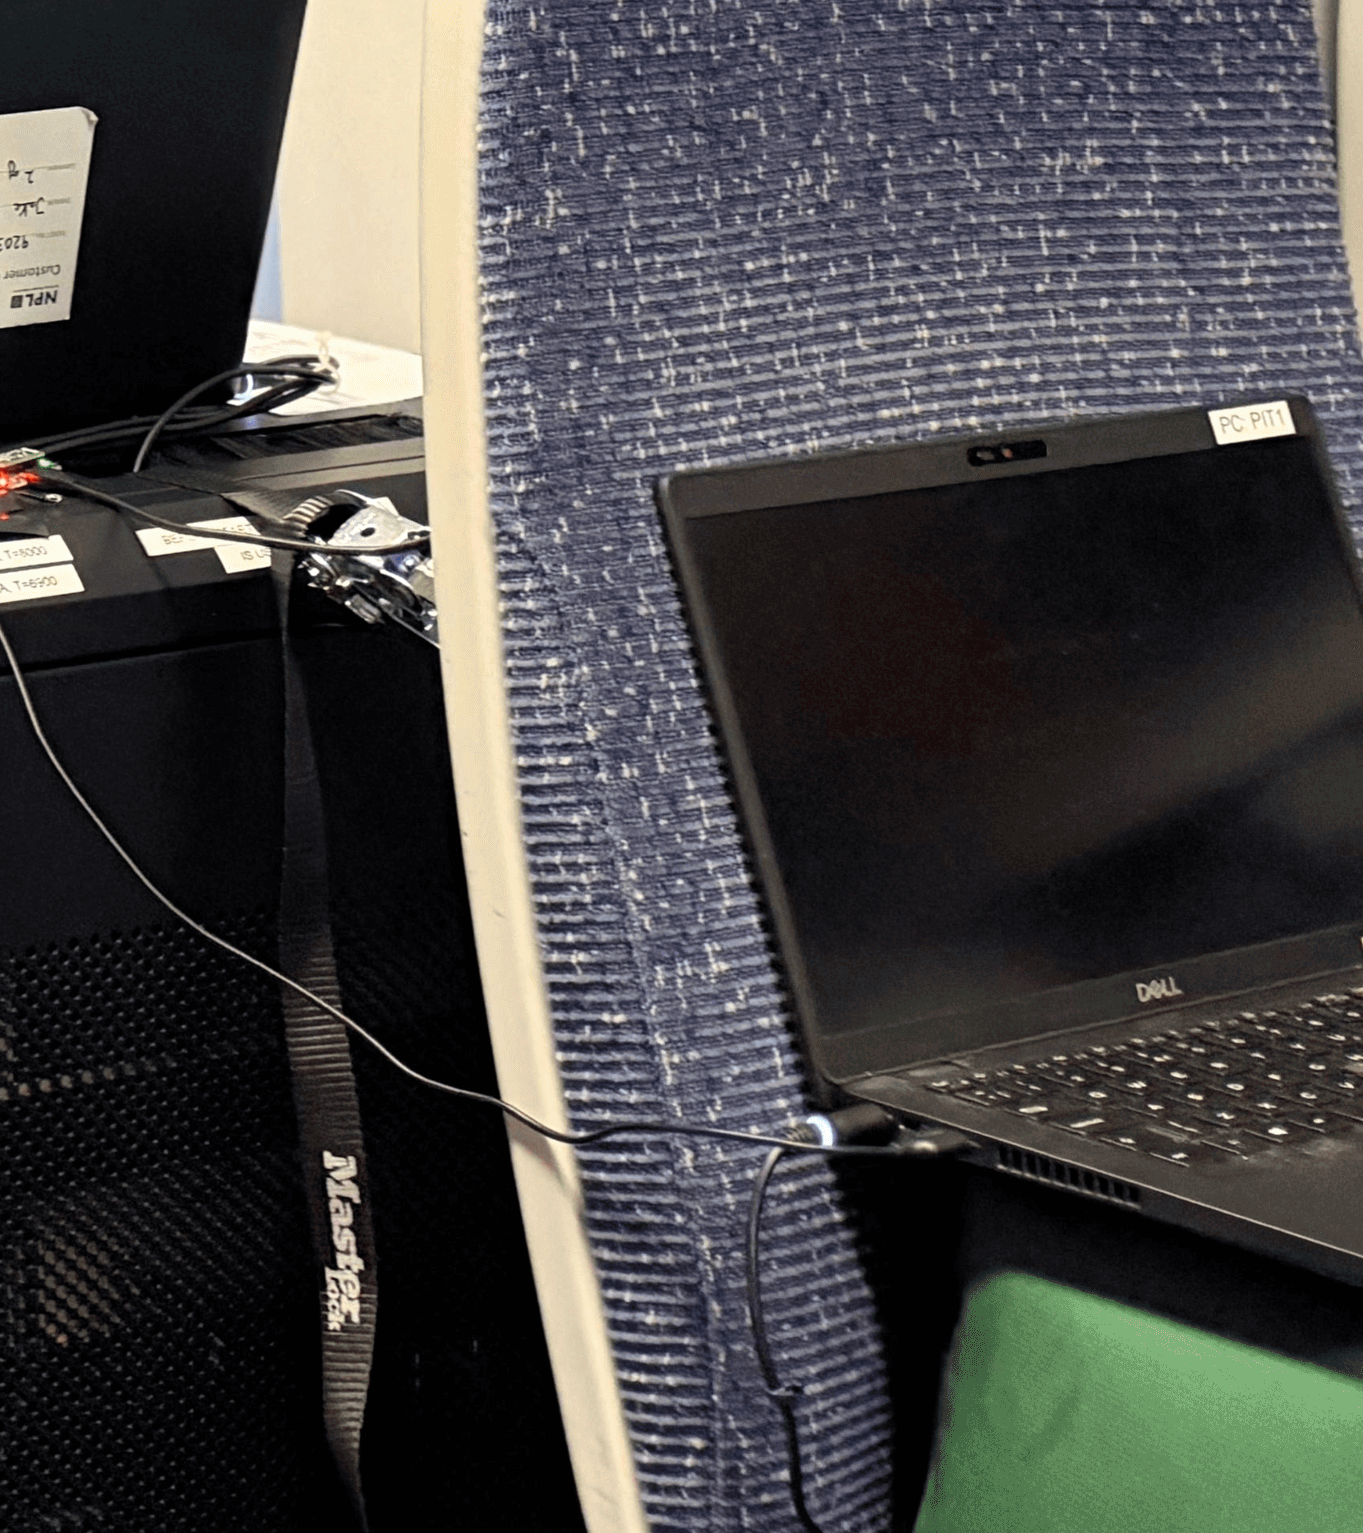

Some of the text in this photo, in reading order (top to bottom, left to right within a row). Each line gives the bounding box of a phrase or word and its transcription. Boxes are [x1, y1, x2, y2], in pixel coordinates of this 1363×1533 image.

[25, 170, 34, 184] 2
[3, 264, 61, 280] Customer
[25, 289, 58, 307] NPL
[1249, 409, 1286, 430] PIT1
[1135, 976, 1184, 1003] DELL
[323, 1150, 366, 1325] Master
[325, 1267, 346, 1332] Lock
